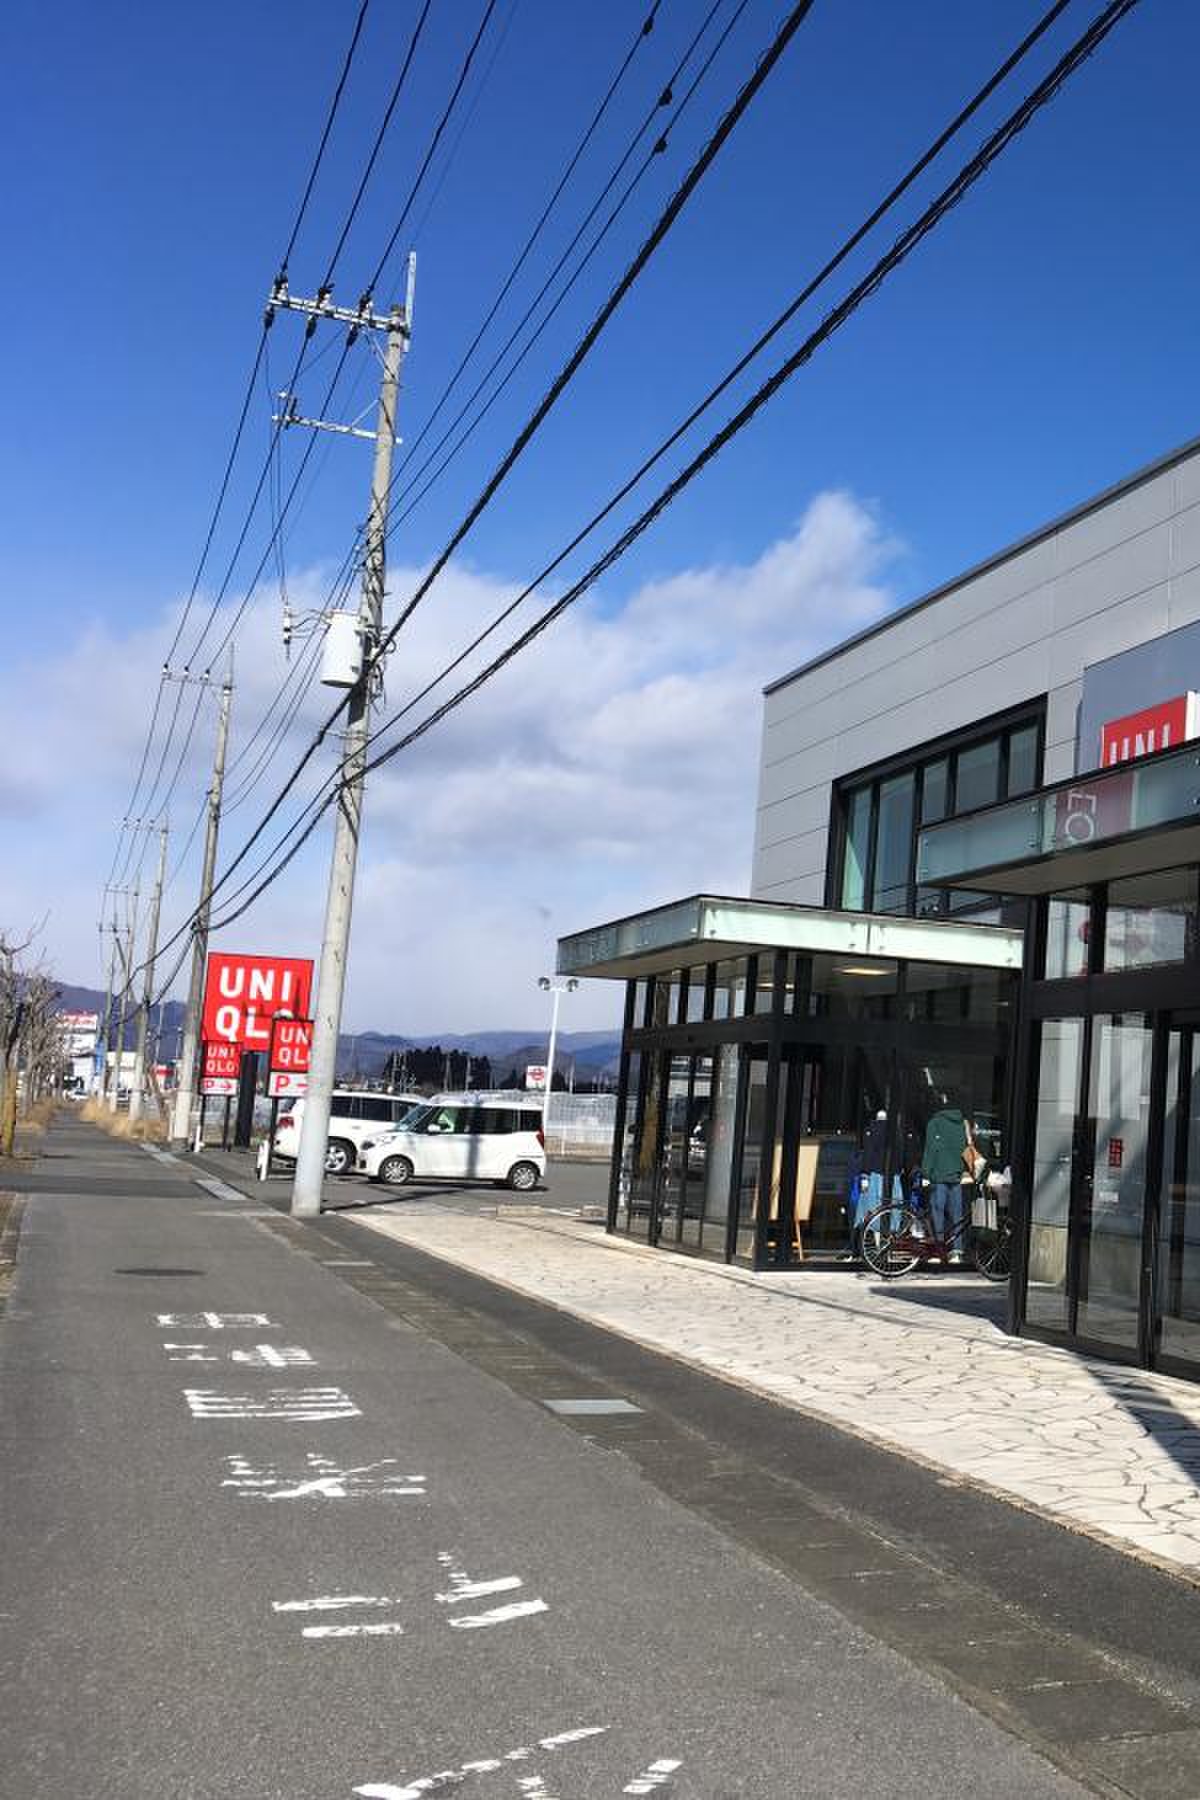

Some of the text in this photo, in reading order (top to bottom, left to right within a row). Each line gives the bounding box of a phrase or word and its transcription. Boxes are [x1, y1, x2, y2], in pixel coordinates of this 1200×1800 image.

[219, 965, 292, 1002] UNI
[215, 1005, 294, 1043] QL
[280, 1026, 310, 1045] UN
[207, 1045, 235, 1058] UNI
[279, 1048, 312, 1068] QL
[206, 1059, 235, 1074] QLO
[276, 1075, 291, 1094] P
